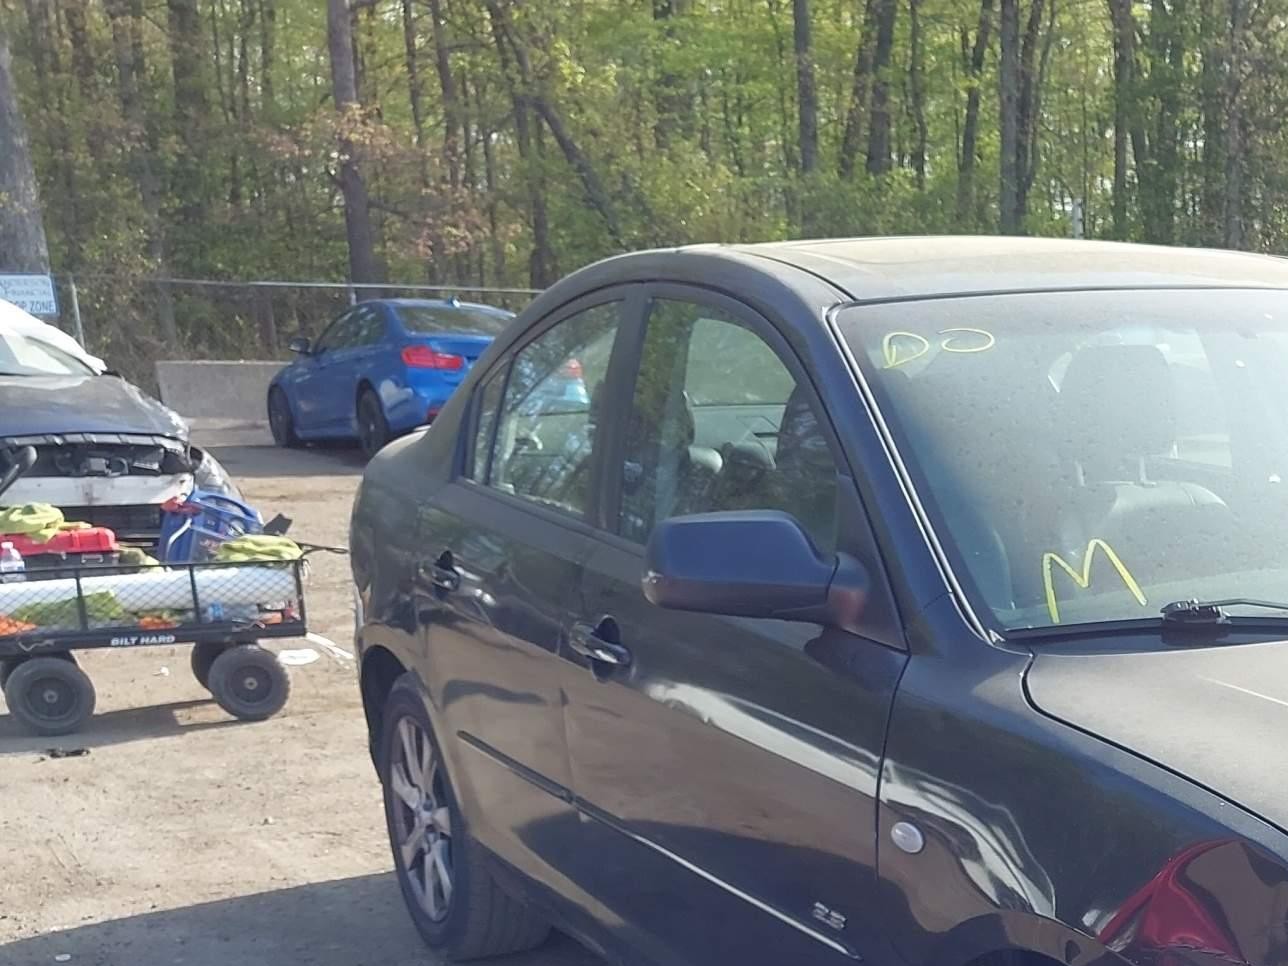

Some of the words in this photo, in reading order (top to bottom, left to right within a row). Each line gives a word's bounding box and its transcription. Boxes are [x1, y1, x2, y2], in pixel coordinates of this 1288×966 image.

[30, 300, 55, 313] ZONE
[1042, 538, 1148, 624] M
[110, 636, 138, 646] BILT
[140, 635, 176, 645] HARD
